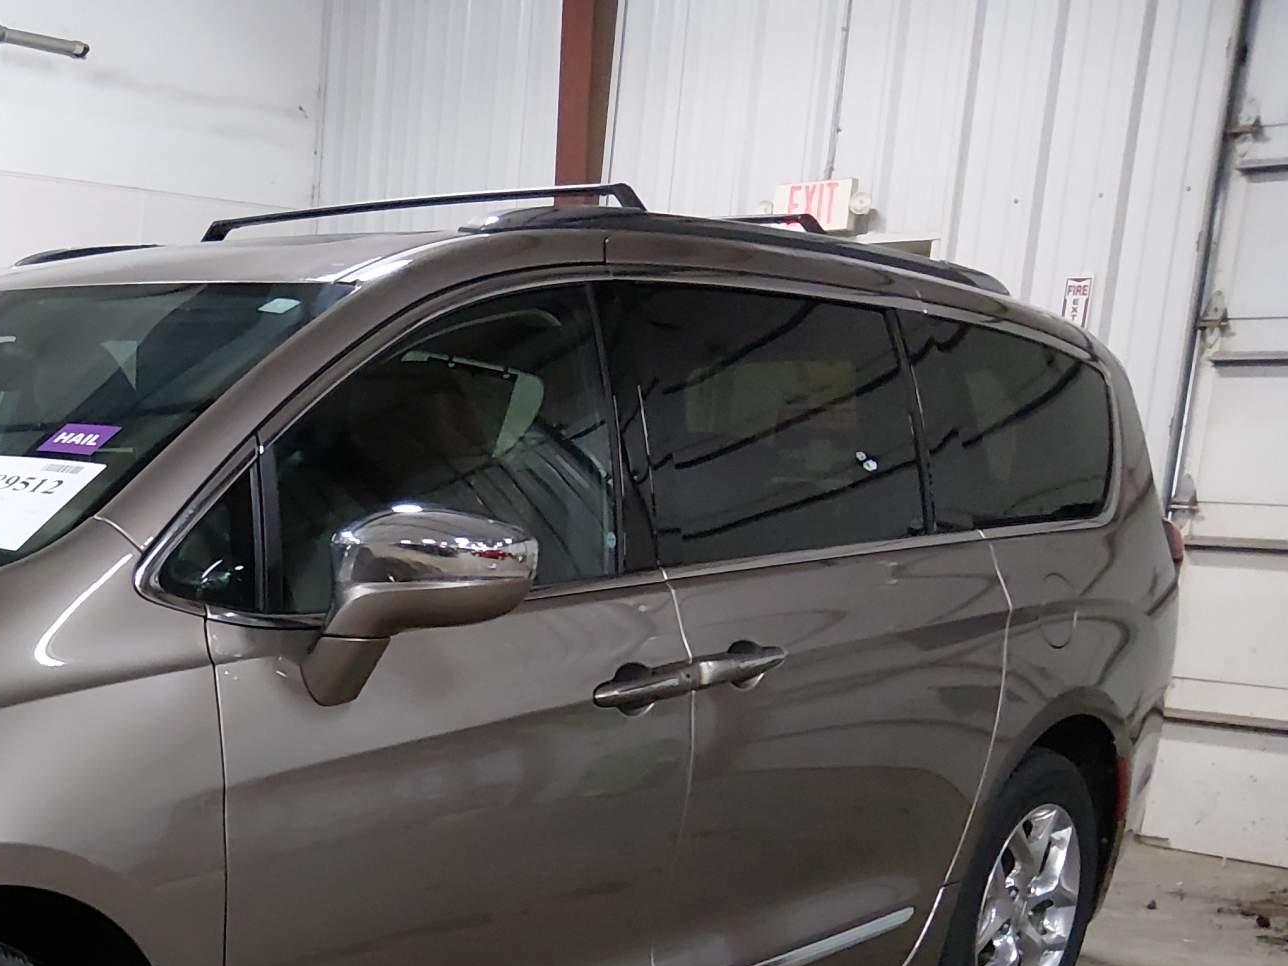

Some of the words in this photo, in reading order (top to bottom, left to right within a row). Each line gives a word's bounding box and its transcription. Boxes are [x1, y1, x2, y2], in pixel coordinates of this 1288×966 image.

[787, 182, 839, 225] EXIT
[1067, 284, 1089, 296] FIRE
[53, 431, 100, 446] HAIL
